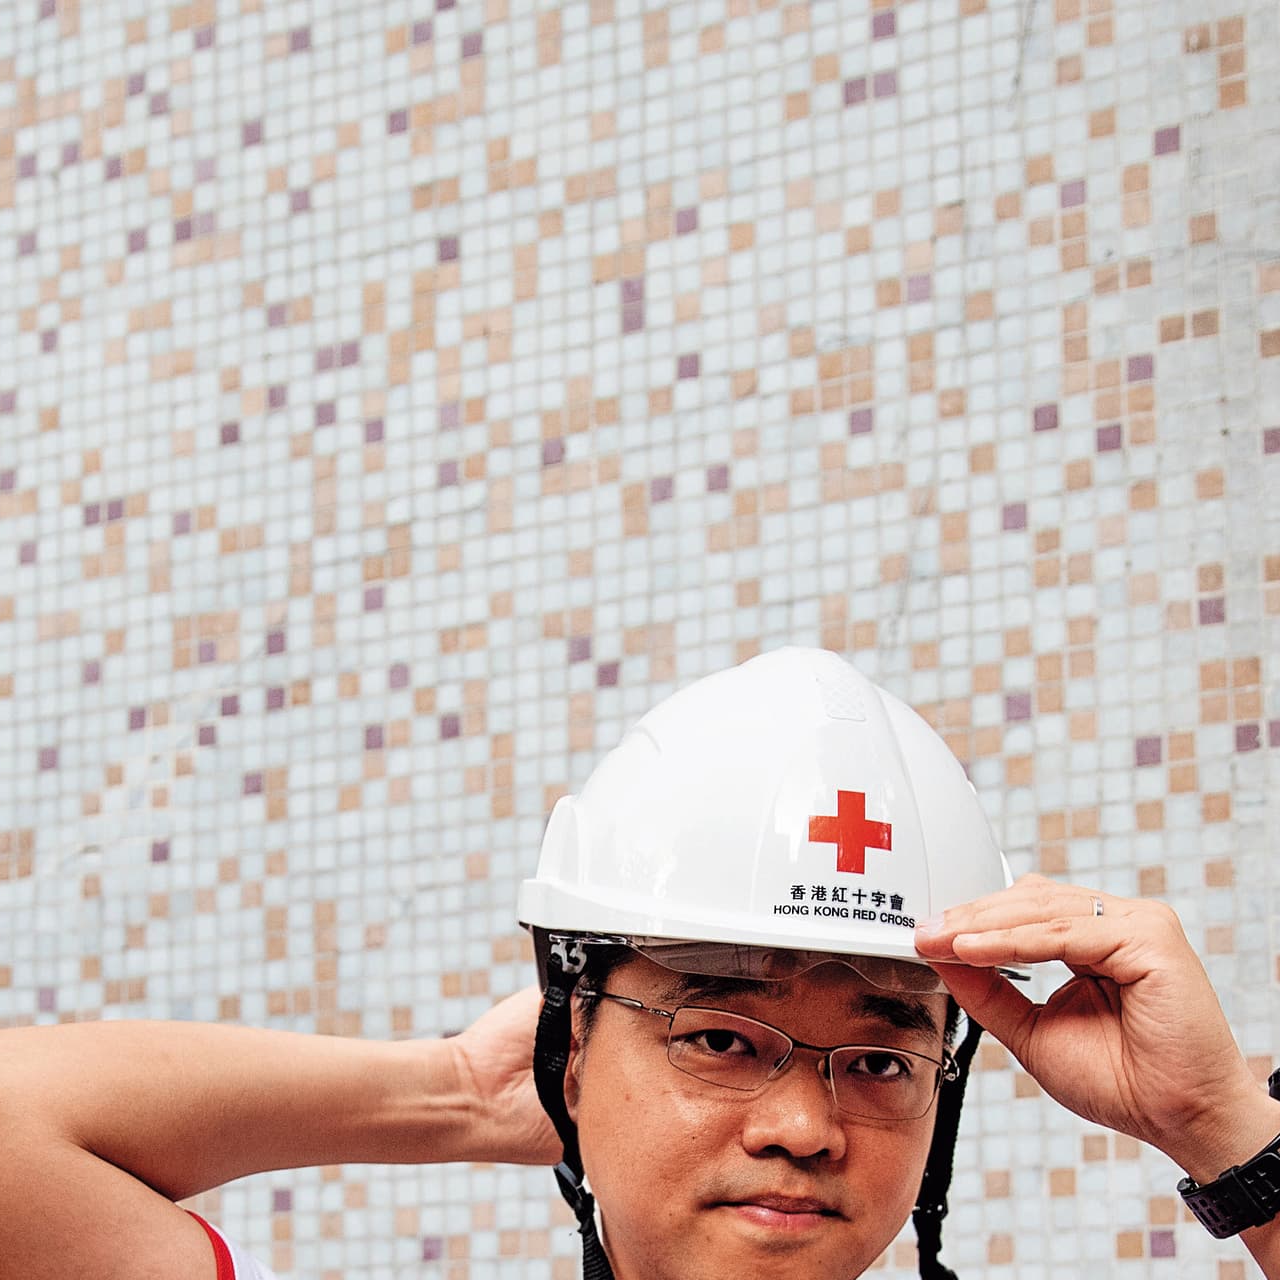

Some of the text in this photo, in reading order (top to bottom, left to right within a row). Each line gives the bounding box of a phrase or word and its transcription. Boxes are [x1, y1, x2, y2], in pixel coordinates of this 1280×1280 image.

[790, 884, 905, 912] 香港紅十字會
[773, 905, 916, 929] HONG KONG RED CROSS
